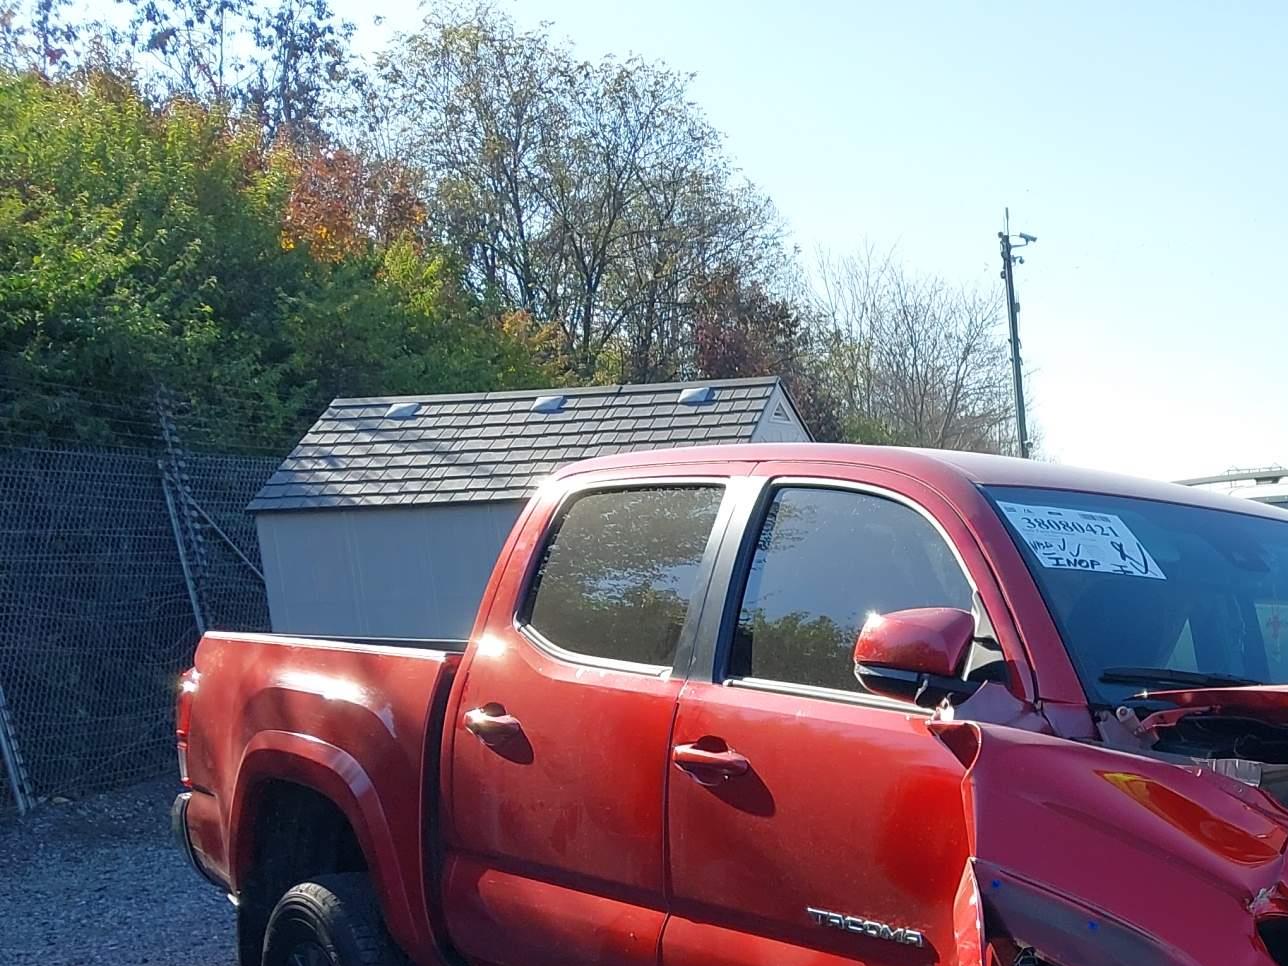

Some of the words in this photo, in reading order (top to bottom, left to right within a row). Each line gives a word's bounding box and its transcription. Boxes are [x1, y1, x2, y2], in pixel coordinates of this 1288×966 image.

[1021, 516, 1120, 538] 38080421
[1047, 556, 1101, 570] INOP
[805, 906, 924, 947] TACOMA
